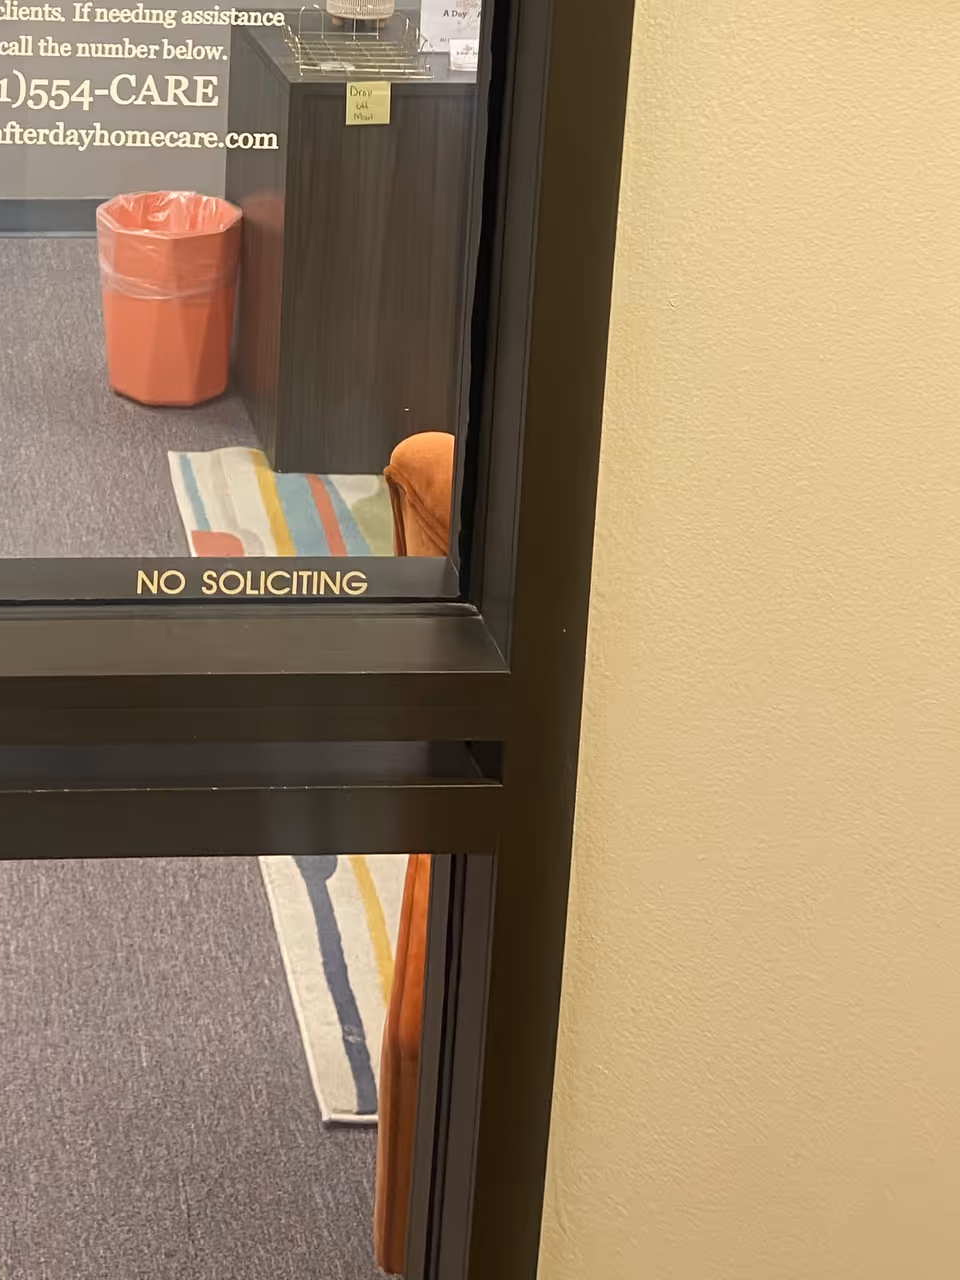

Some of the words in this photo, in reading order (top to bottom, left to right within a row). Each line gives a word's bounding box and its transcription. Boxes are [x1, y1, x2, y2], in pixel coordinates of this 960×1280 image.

[72, 2, 93, 22] If
[94, 3, 178, 29] needing
[181, 5, 286, 26] assistance
[443, 10, 450, 18] A
[452, 10, 468, 20] Day
[38, 36, 72, 56] the
[76, 38, 160, 59] number
[162, 38, 229, 61] below.
[350, 85, 373, 99] Drop
[136, 570, 186, 595] NO
[201, 570, 368, 595] SOLICITING
